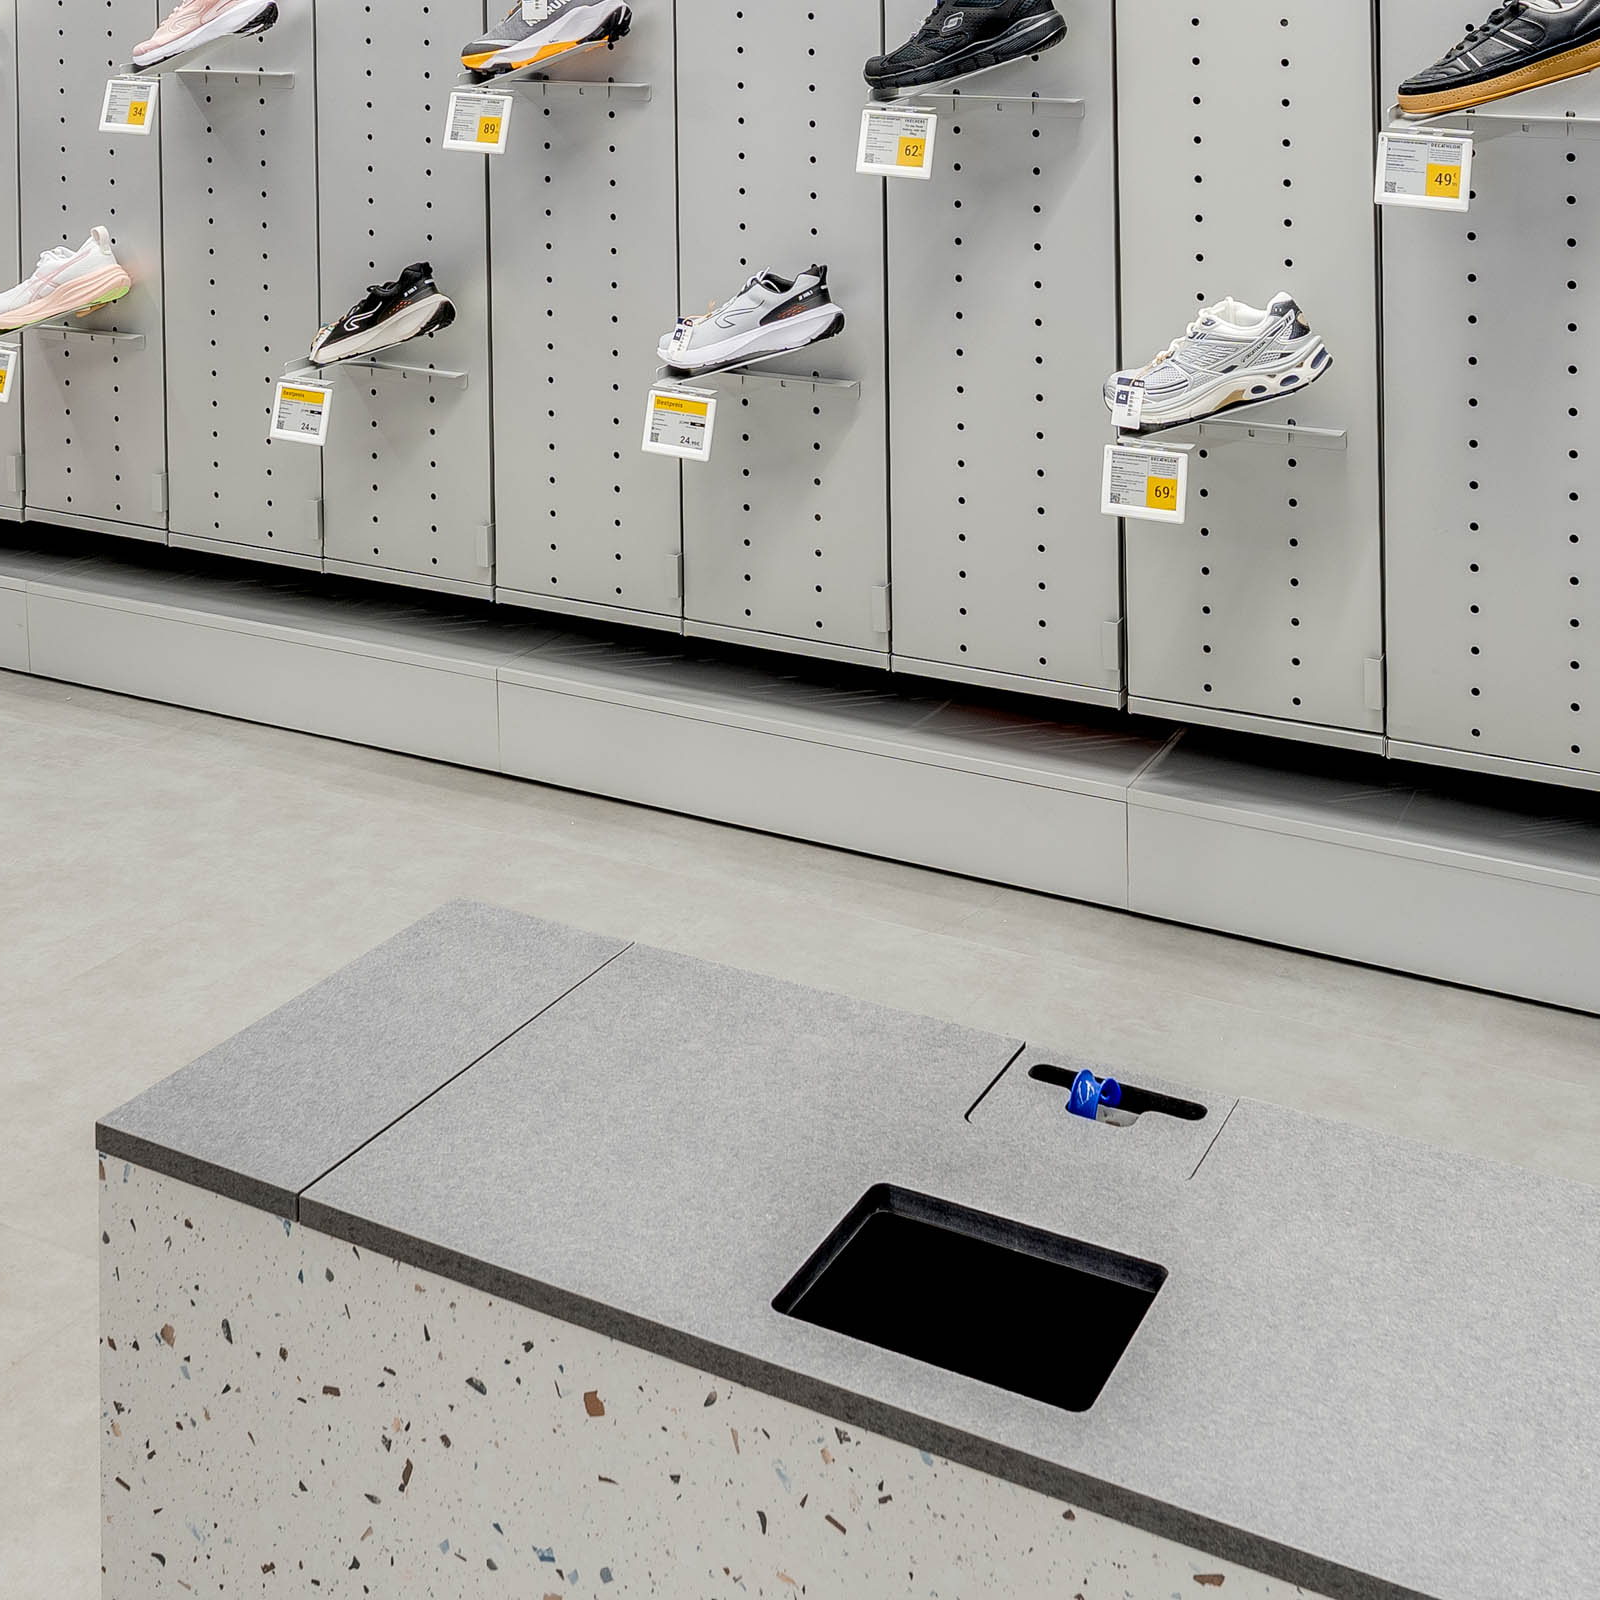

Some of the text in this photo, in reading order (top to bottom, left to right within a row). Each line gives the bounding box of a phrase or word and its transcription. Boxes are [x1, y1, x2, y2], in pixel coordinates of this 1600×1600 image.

[132, 106, 143, 117] 34
[484, 123, 496, 134] 89
[904, 145, 918, 157] 62
[1434, 173, 1452, 186] 49
[1154, 485, 1170, 499] 69
